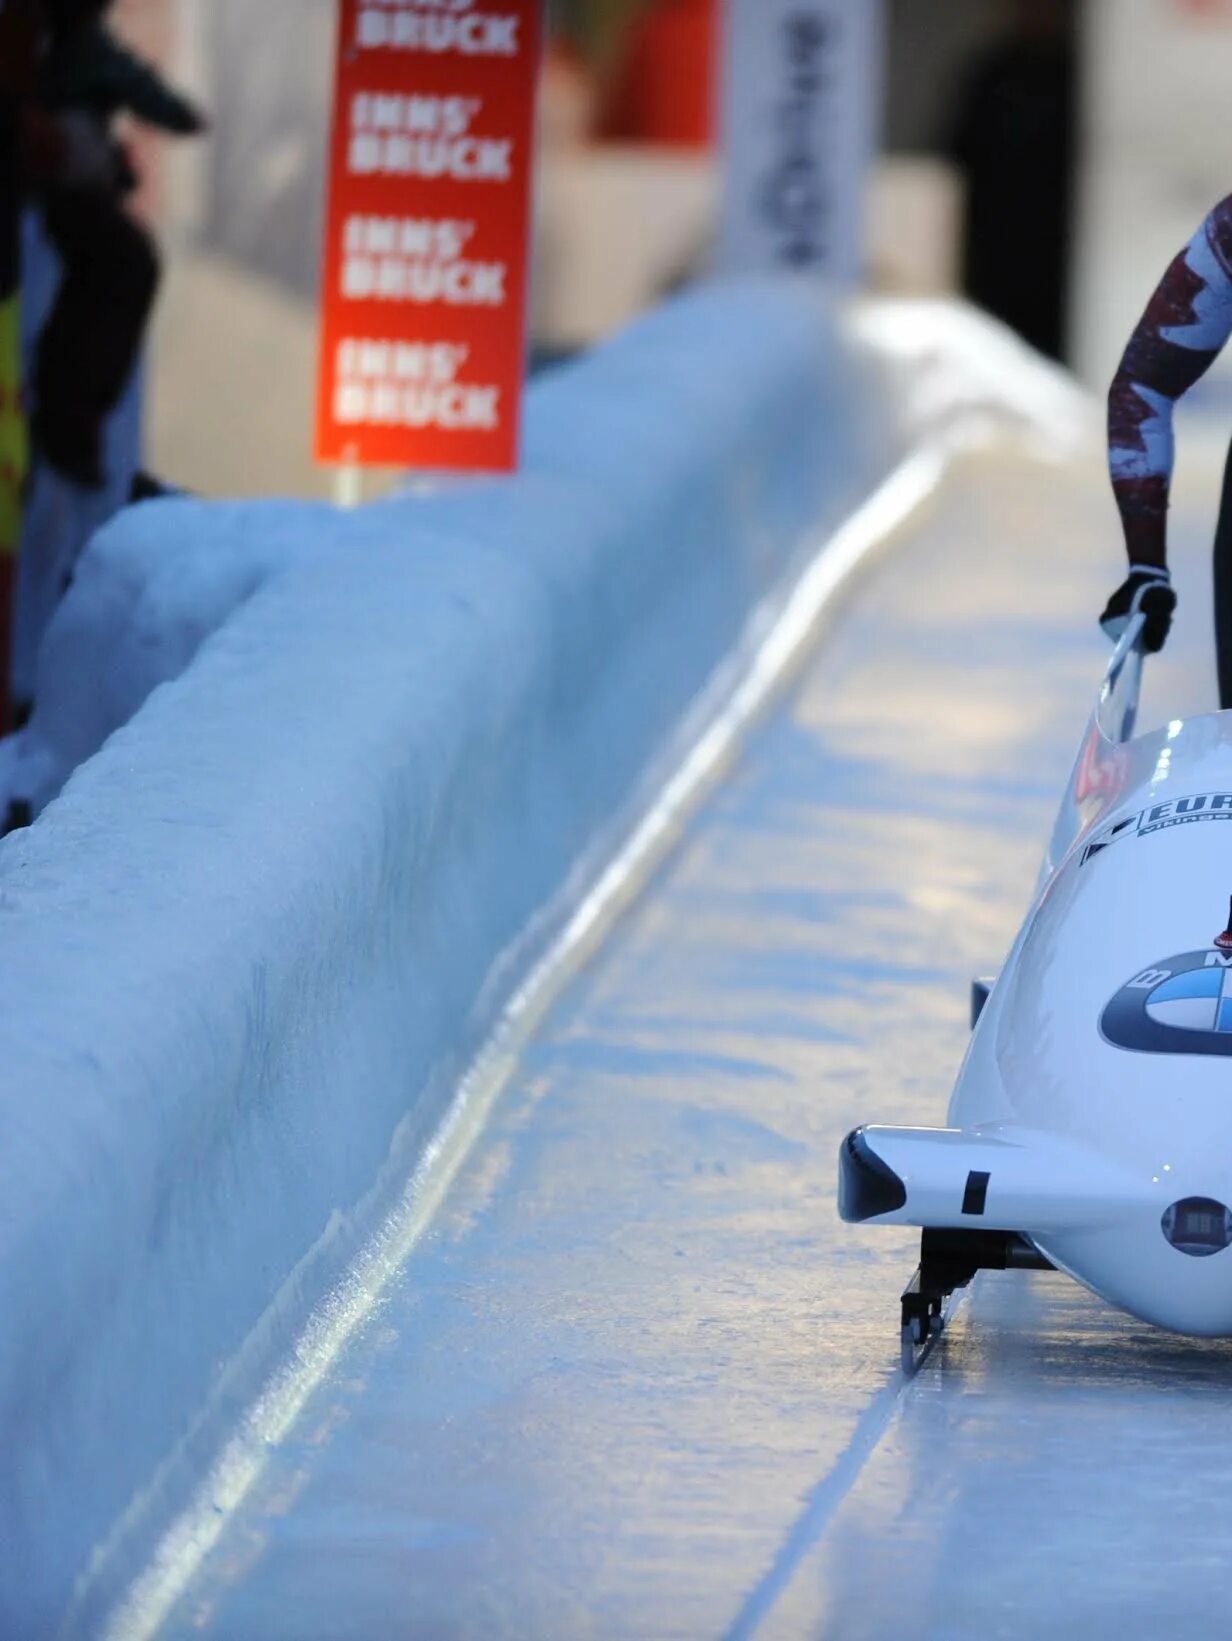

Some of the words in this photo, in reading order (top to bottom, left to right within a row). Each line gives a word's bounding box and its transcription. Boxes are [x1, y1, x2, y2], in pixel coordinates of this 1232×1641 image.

[356, 9, 518, 56] BRUCK
[348, 132, 514, 181] BRUCK
[340, 256, 506, 305] BRUCK
[333, 379, 498, 429] BRUCK
